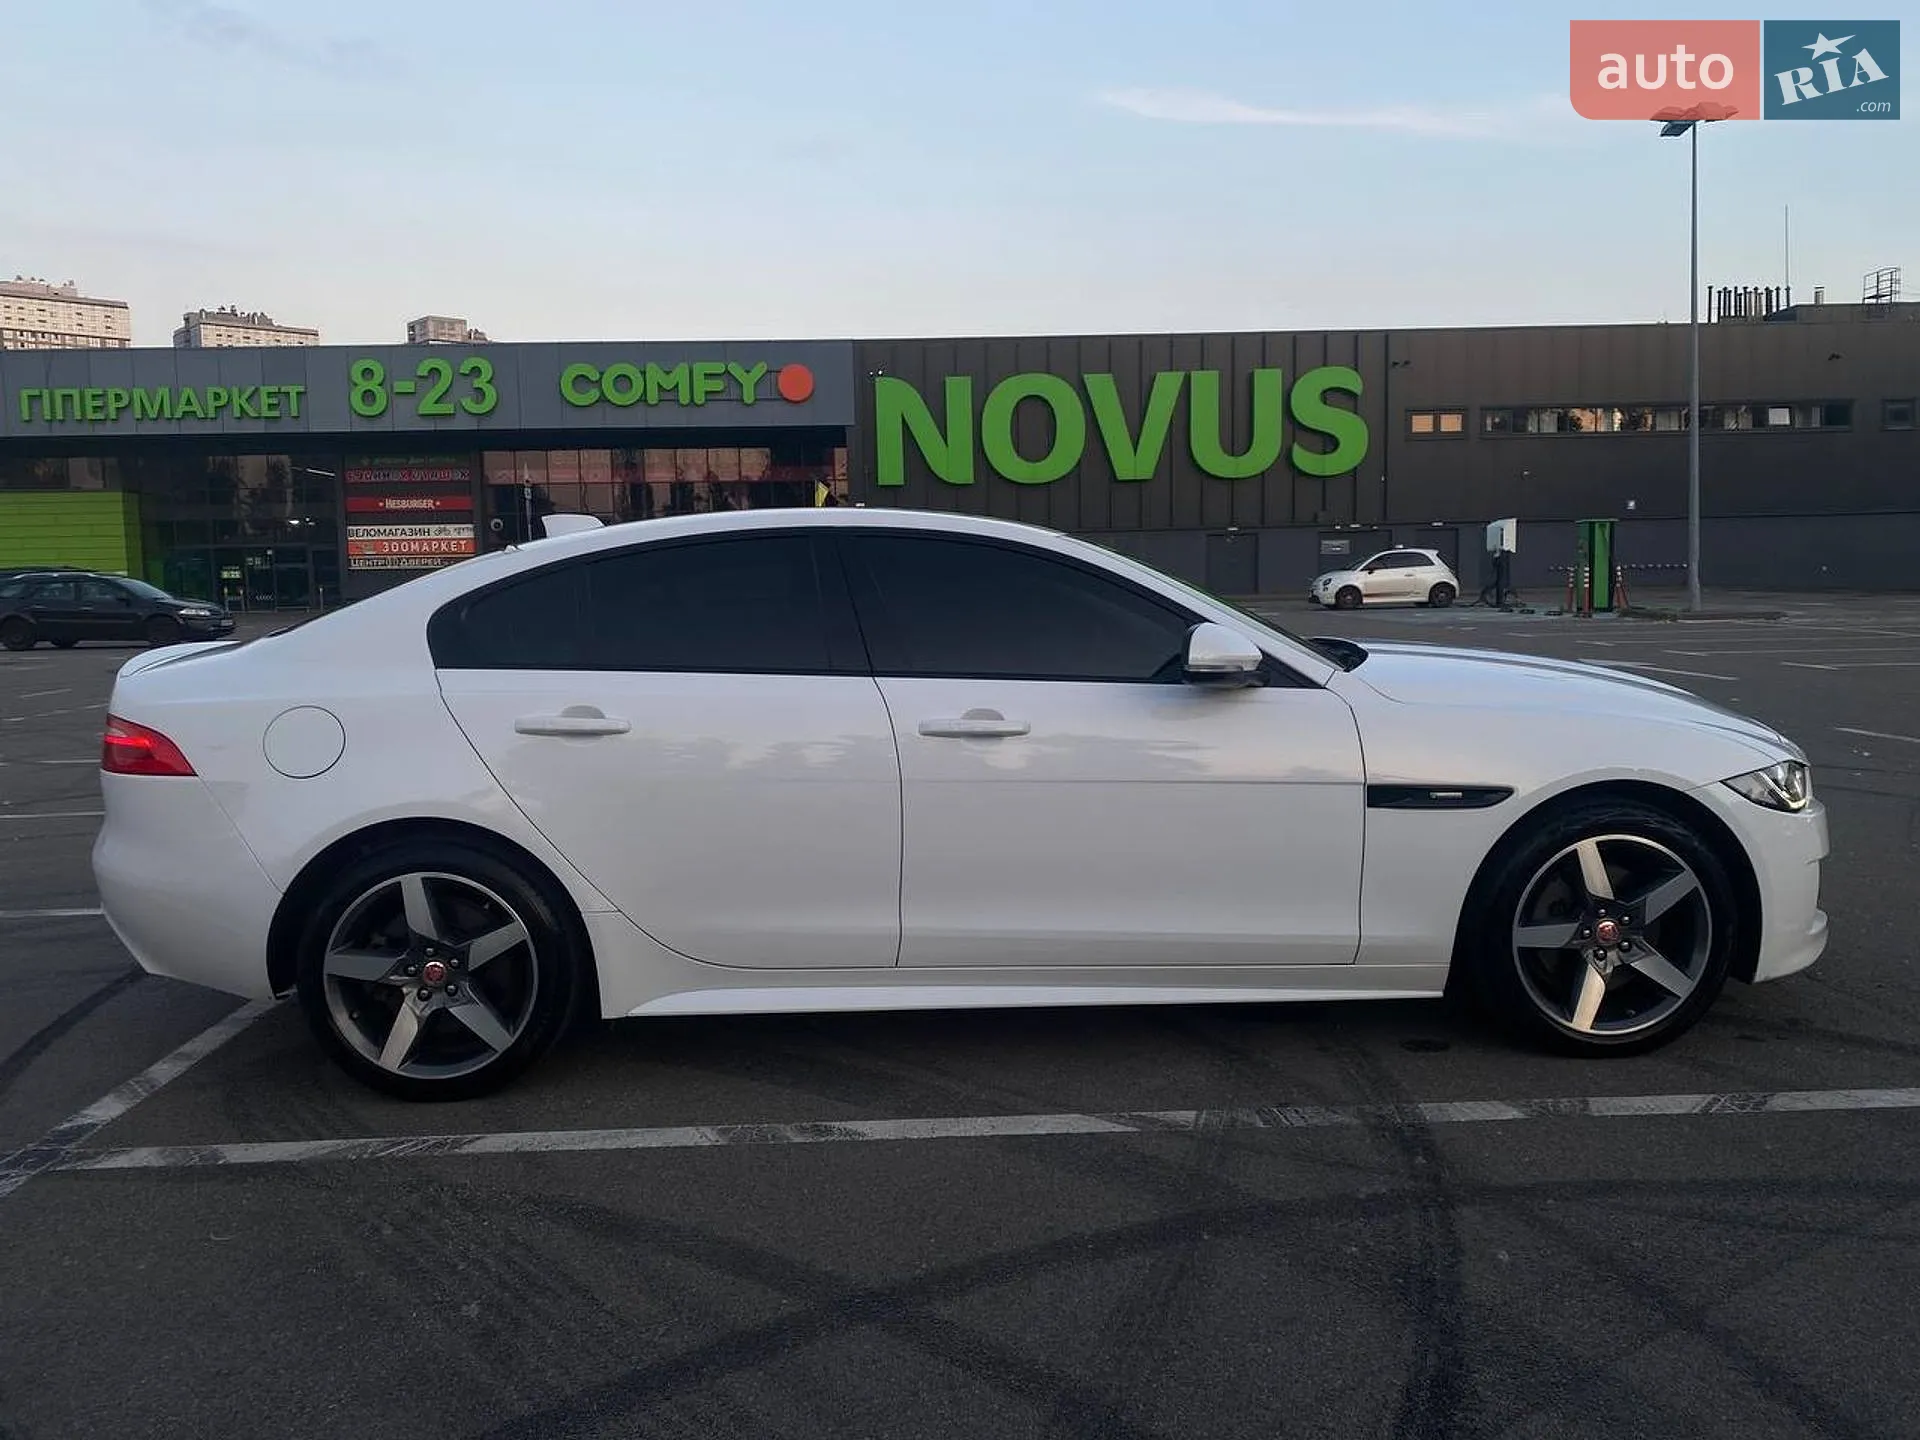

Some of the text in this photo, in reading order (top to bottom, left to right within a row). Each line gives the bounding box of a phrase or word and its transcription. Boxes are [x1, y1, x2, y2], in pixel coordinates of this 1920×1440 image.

[19, 385, 305, 423] ГІПЕРМАРКЕТ
[349, 356, 498, 418] 8-23
[560, 361, 768, 407] COMFY
[874, 365, 1370, 486] NOVUS
[348, 527, 430, 538] ВЕЛОМАГАЗИН
[383, 540, 467, 553] ЗООМАРКЕТ
